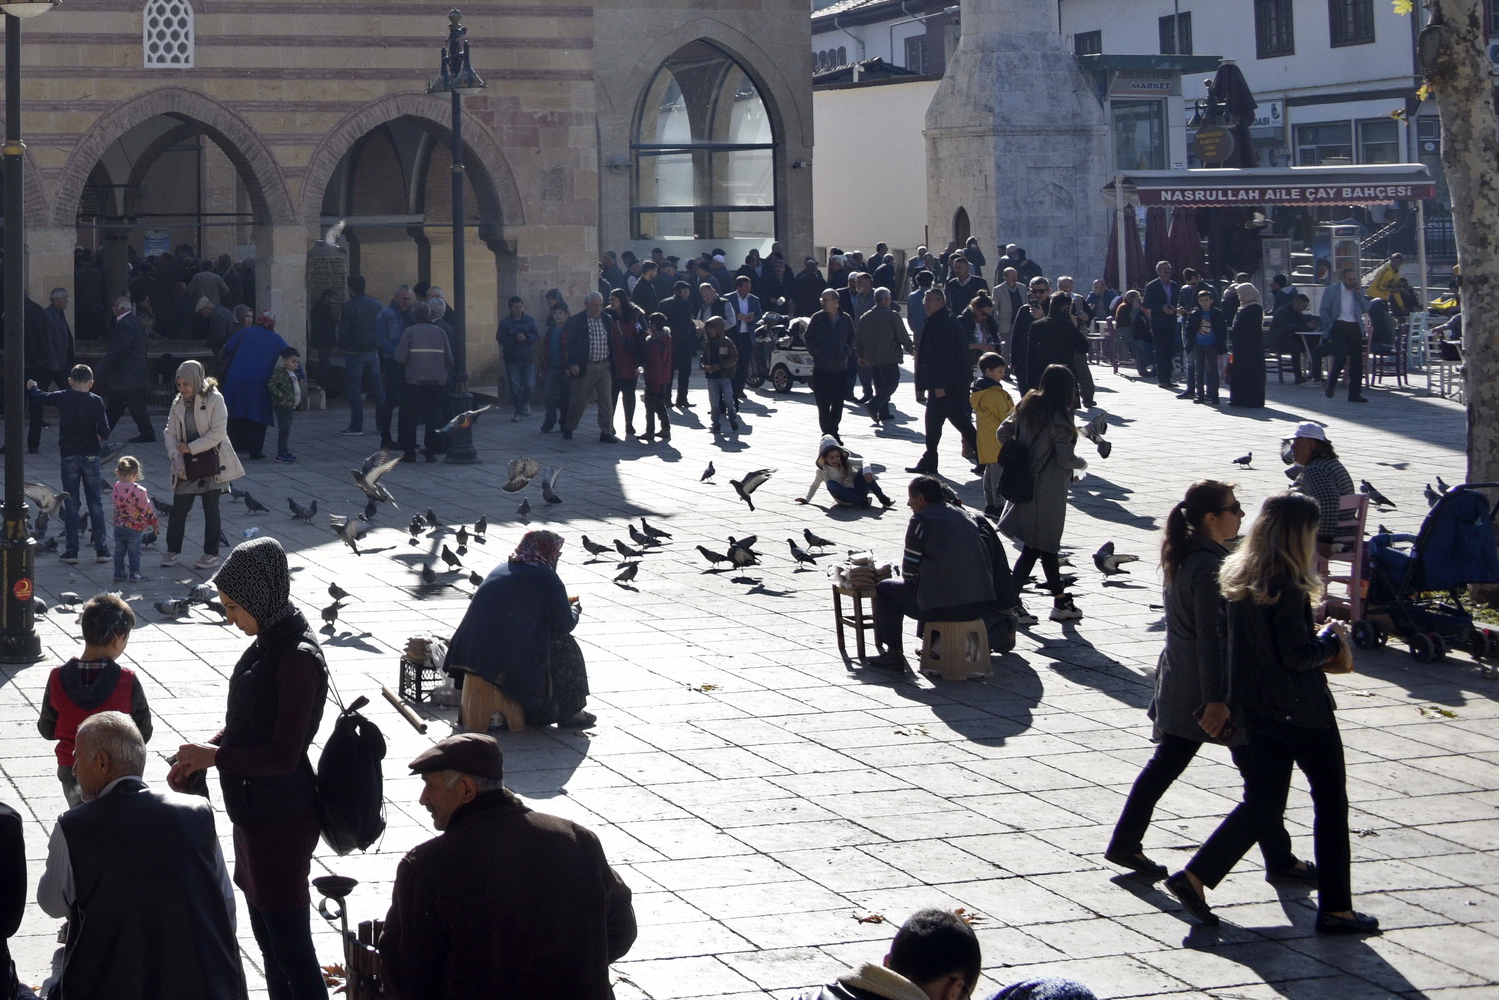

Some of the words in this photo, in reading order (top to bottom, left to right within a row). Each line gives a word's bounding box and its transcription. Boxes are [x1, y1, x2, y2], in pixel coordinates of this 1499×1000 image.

[1131, 82, 1171, 90] MARKET
[1160, 189, 1259, 201] NASRULLAH
[1305, 187, 1337, 201] ÇAY
